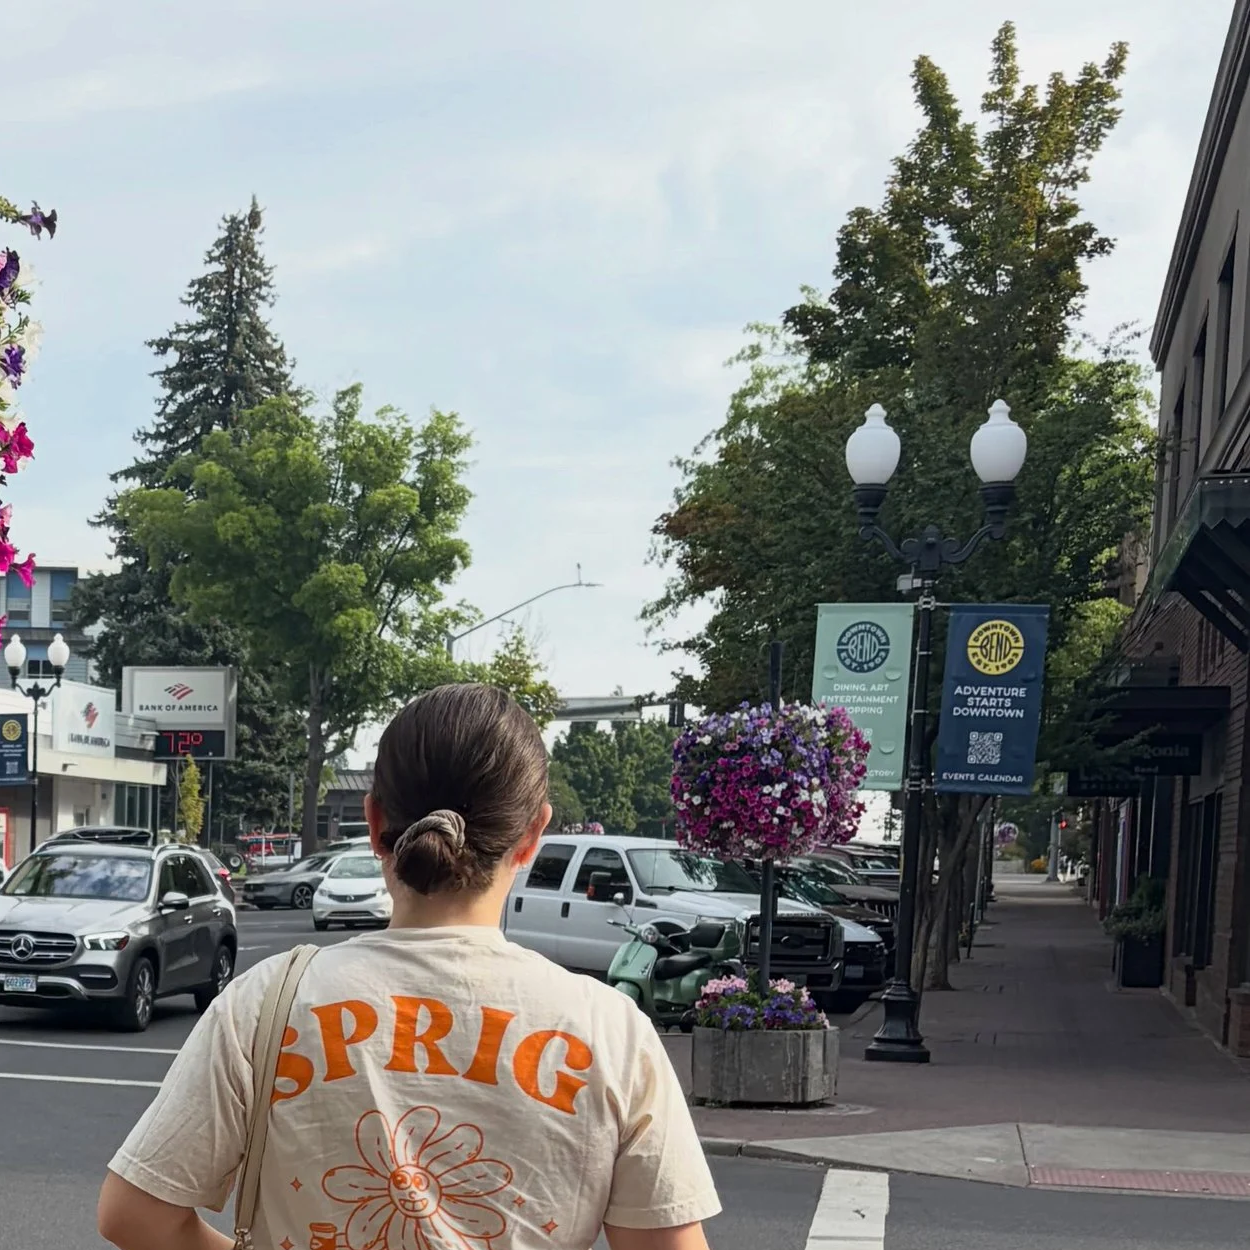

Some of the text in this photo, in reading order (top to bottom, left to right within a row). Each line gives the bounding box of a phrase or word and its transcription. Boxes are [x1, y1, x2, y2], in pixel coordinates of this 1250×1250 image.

[841, 624, 887, 643] DOWNTOWN
[973, 623, 1020, 643] DOWNTOWN
[848, 632, 879, 662] BEND
[980, 631, 1012, 662] BEND
[840, 651, 886, 671] EST. 1903
[971, 652, 1019, 671] EST. 1903
[870, 684, 890, 692] ART
[953, 685, 1027, 697] ADVENTURE
[821, 695, 900, 704] ENTERTAINMENT
[967, 697, 1012, 707] STARTS
[139, 704, 218, 712] BANK OF AMERICA
[846, 706, 884, 715] OPPING
[952, 706, 1025, 718] DOWNTOWN
[868, 769, 895, 777] CTORY
[942, 772, 1024, 783] EVENTS CALENDAR
[271, 995, 593, 1115] SPRIG
